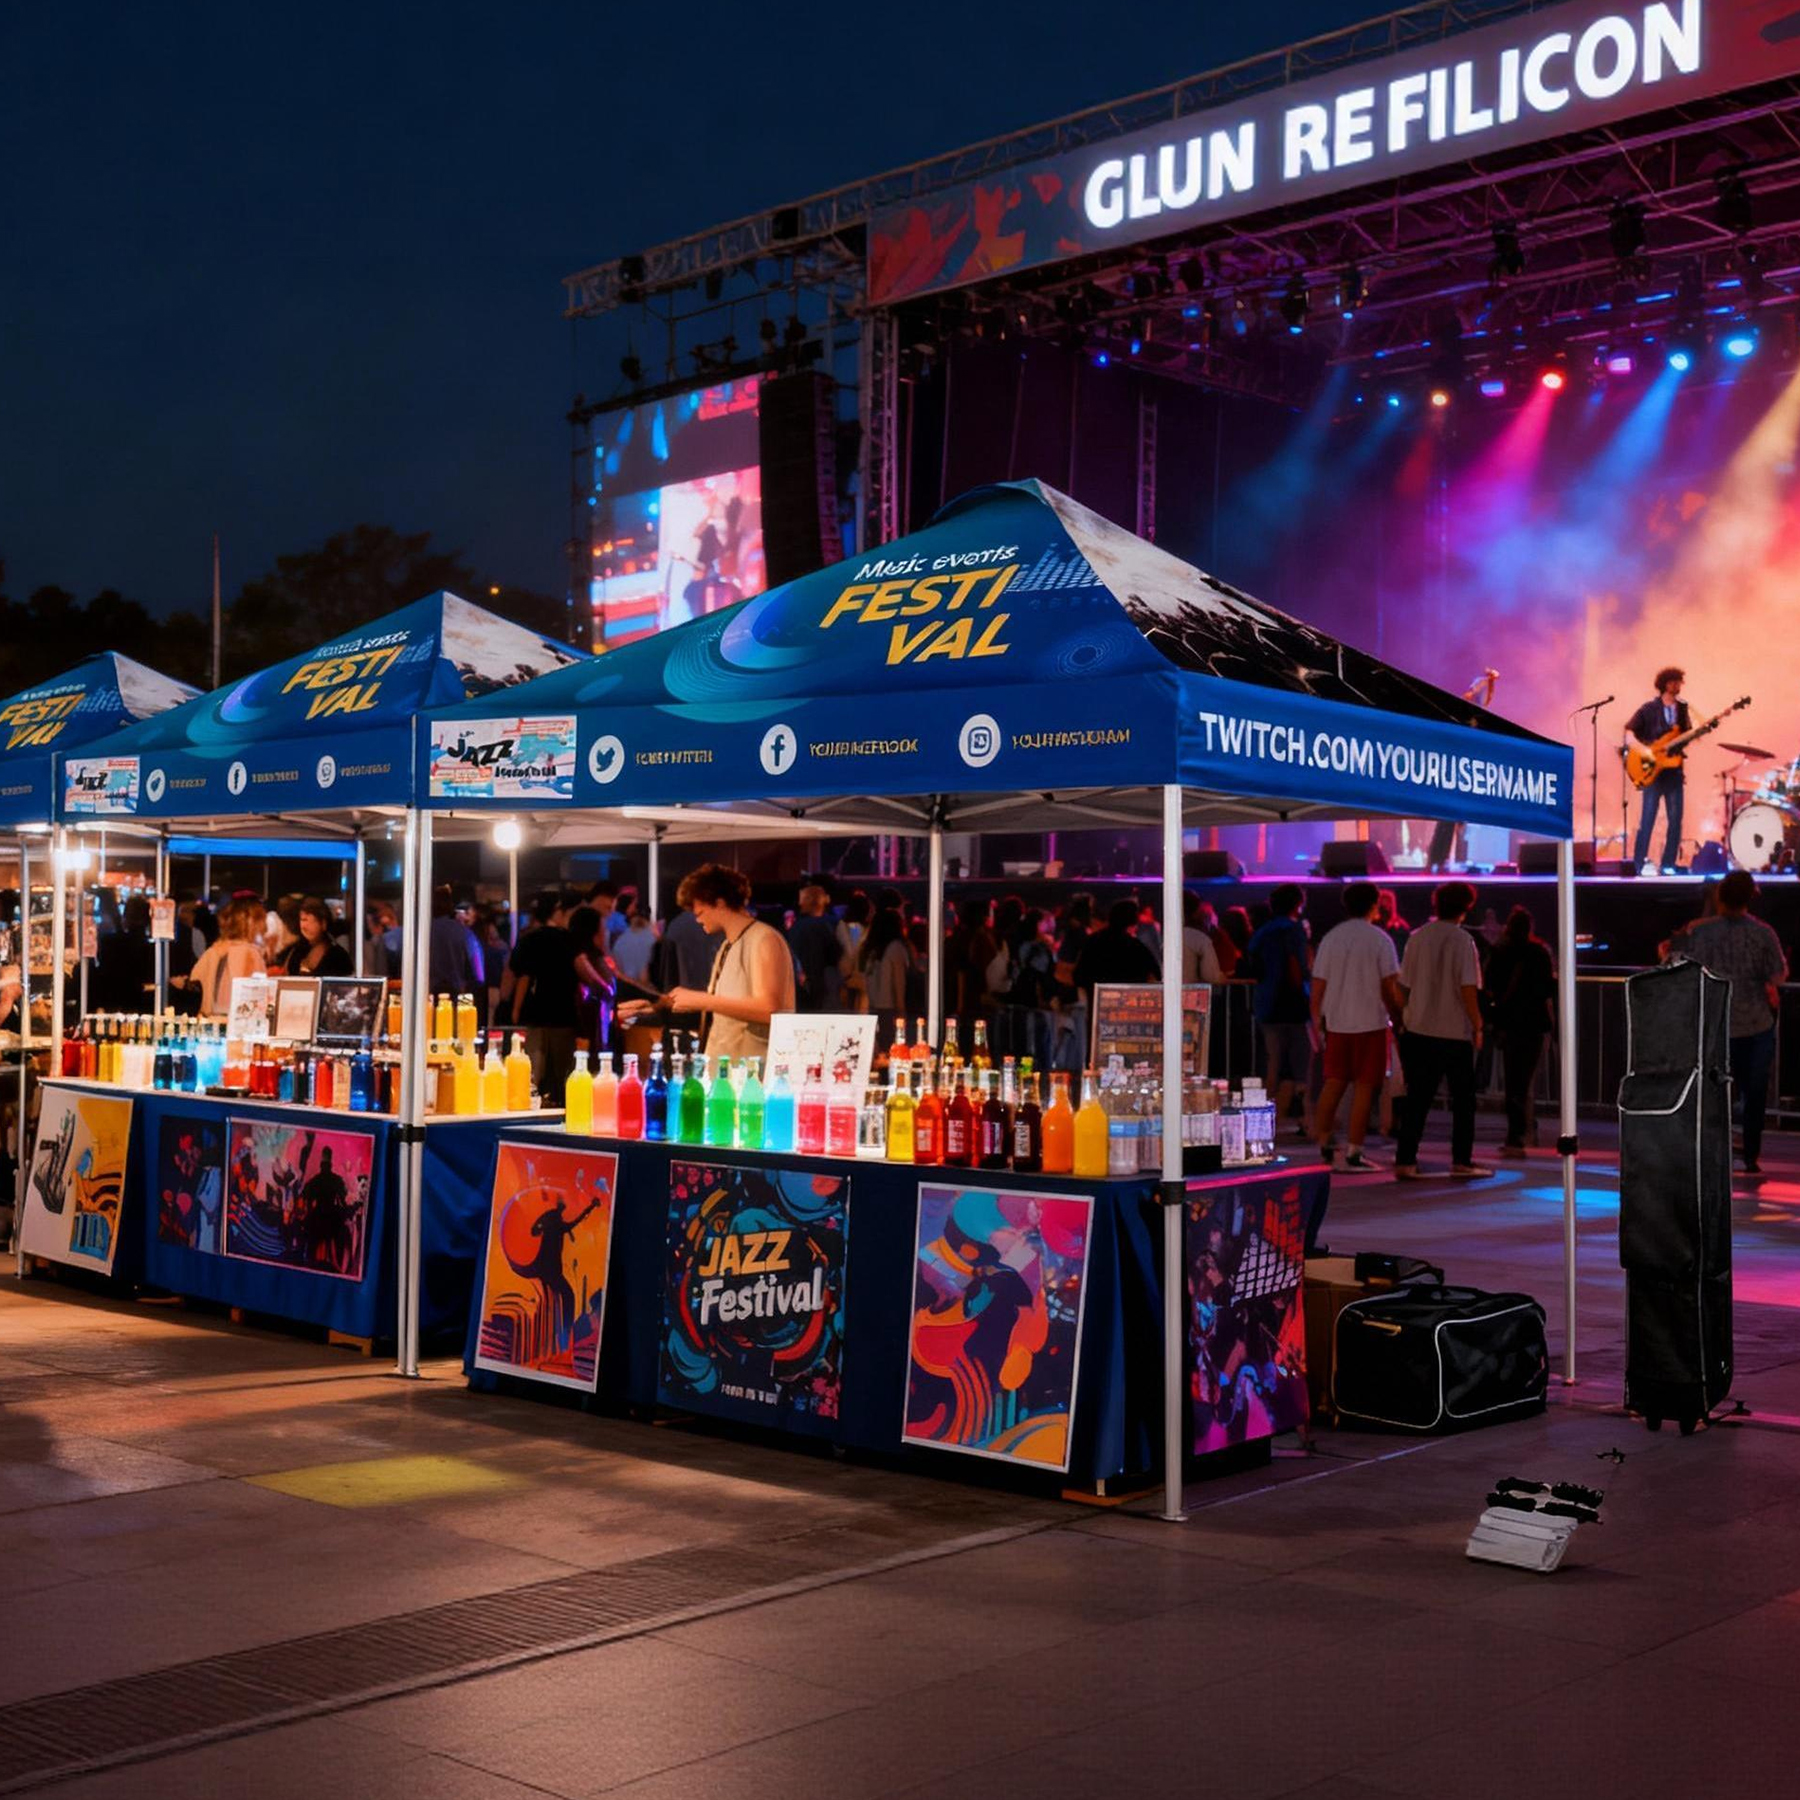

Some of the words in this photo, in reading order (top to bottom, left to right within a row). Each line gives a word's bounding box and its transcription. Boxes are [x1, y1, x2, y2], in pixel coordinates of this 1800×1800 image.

[1084, 121, 1256, 229] GLUN
[819, 564, 1020, 628] FESTI
[885, 613, 1010, 665] VAL
[281, 645, 405, 694] FESTI
[305, 682, 381, 720] VAL
[447, 738, 515, 767] JAZZ
[698, 1231, 792, 1277] JAZZ
[700, 1267, 824, 1326] Festival
